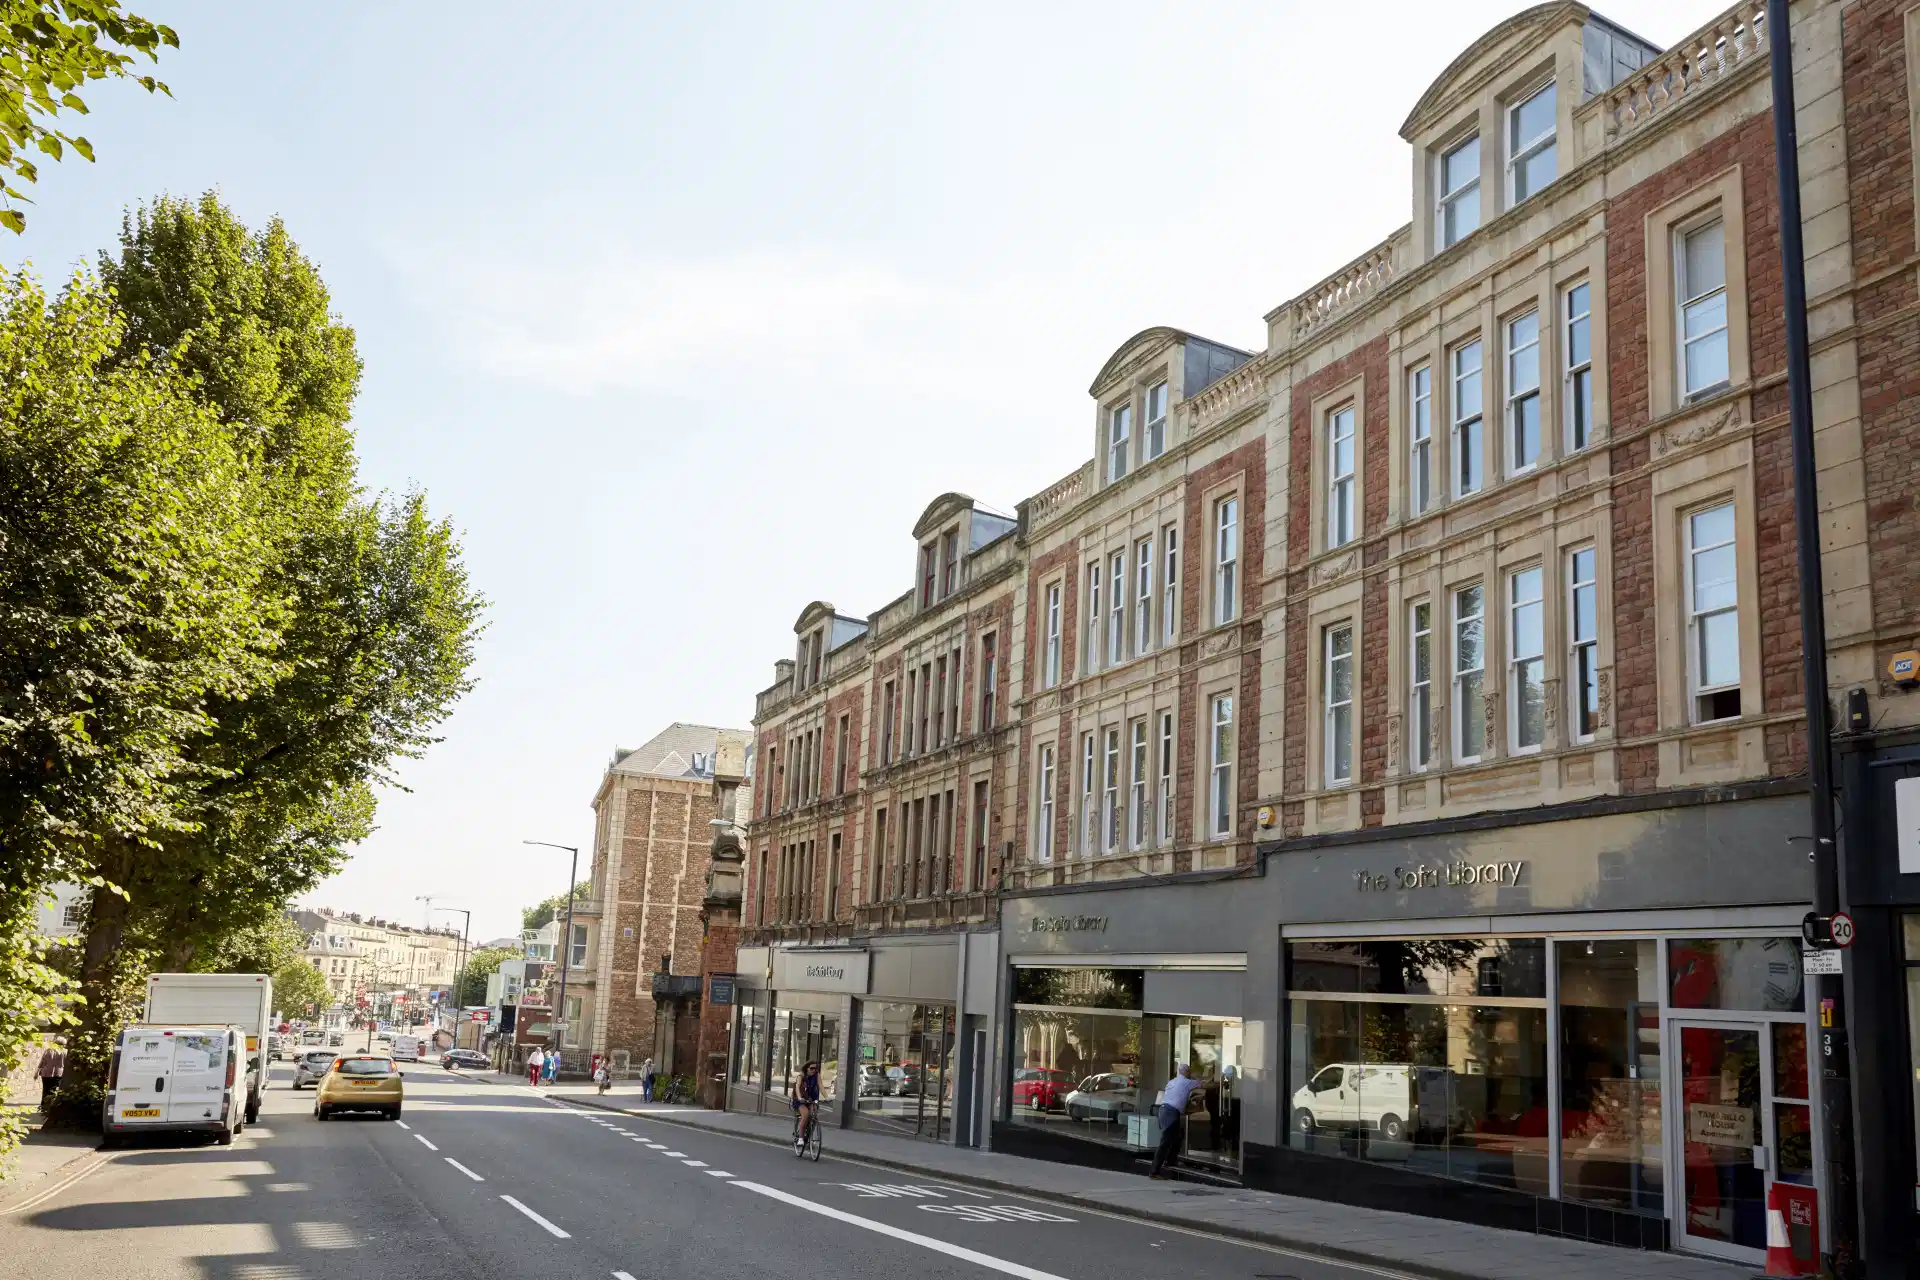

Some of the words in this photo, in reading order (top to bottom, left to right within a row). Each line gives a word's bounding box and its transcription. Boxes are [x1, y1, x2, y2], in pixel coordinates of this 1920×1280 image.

[1895, 661, 1913, 671] ADT
[1353, 868, 1388, 892] The
[1394, 864, 1440, 891] Sofa
[1446, 860, 1523, 887] Library
[1834, 922, 1852, 938] 20
[818, 1183, 993, 1199] LANE
[916, 1204, 1079, 1223] BUS
